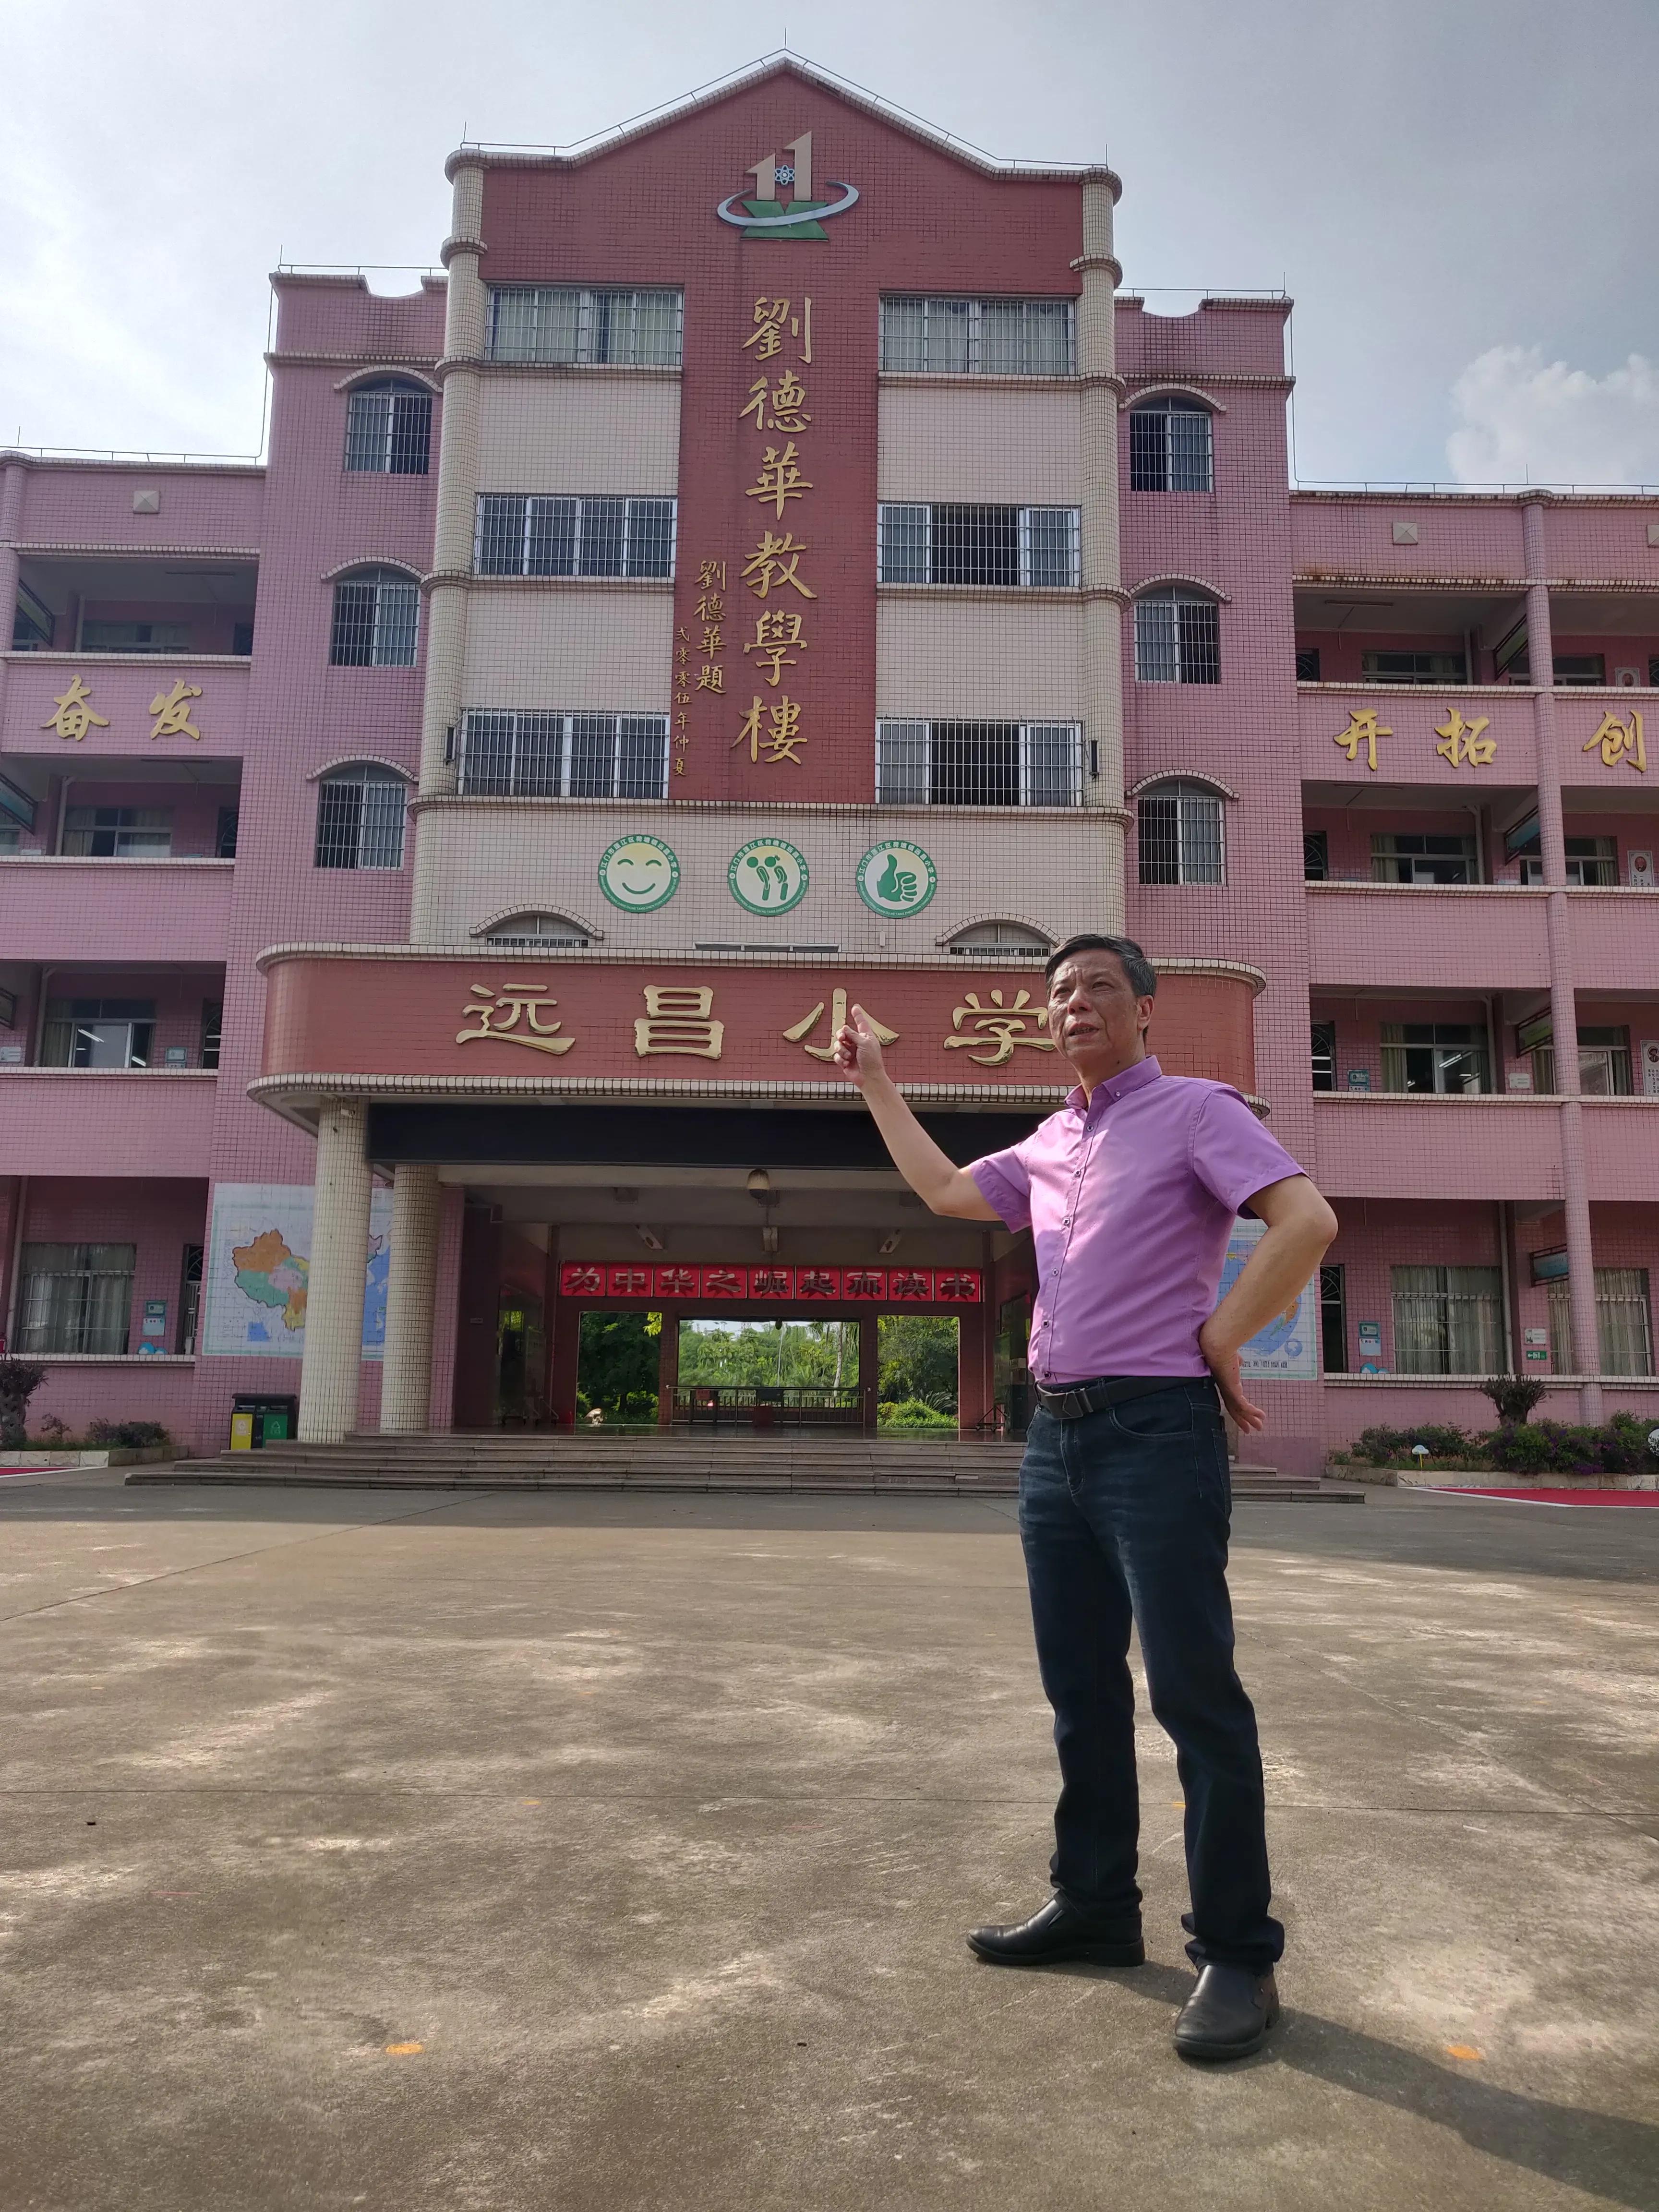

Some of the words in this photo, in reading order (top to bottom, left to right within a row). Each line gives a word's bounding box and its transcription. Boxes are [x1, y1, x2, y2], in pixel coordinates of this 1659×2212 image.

[731, 296, 817, 766] 劉德華教學樓
[693, 560, 727, 694] 劉德華題
[40, 674, 203, 741] 奋发
[1333, 707, 1647, 773] 开拓创
[456, 984, 1056, 1066] 远昌小学
[565, 1266, 976, 1297] 为中华之崛起而读书
